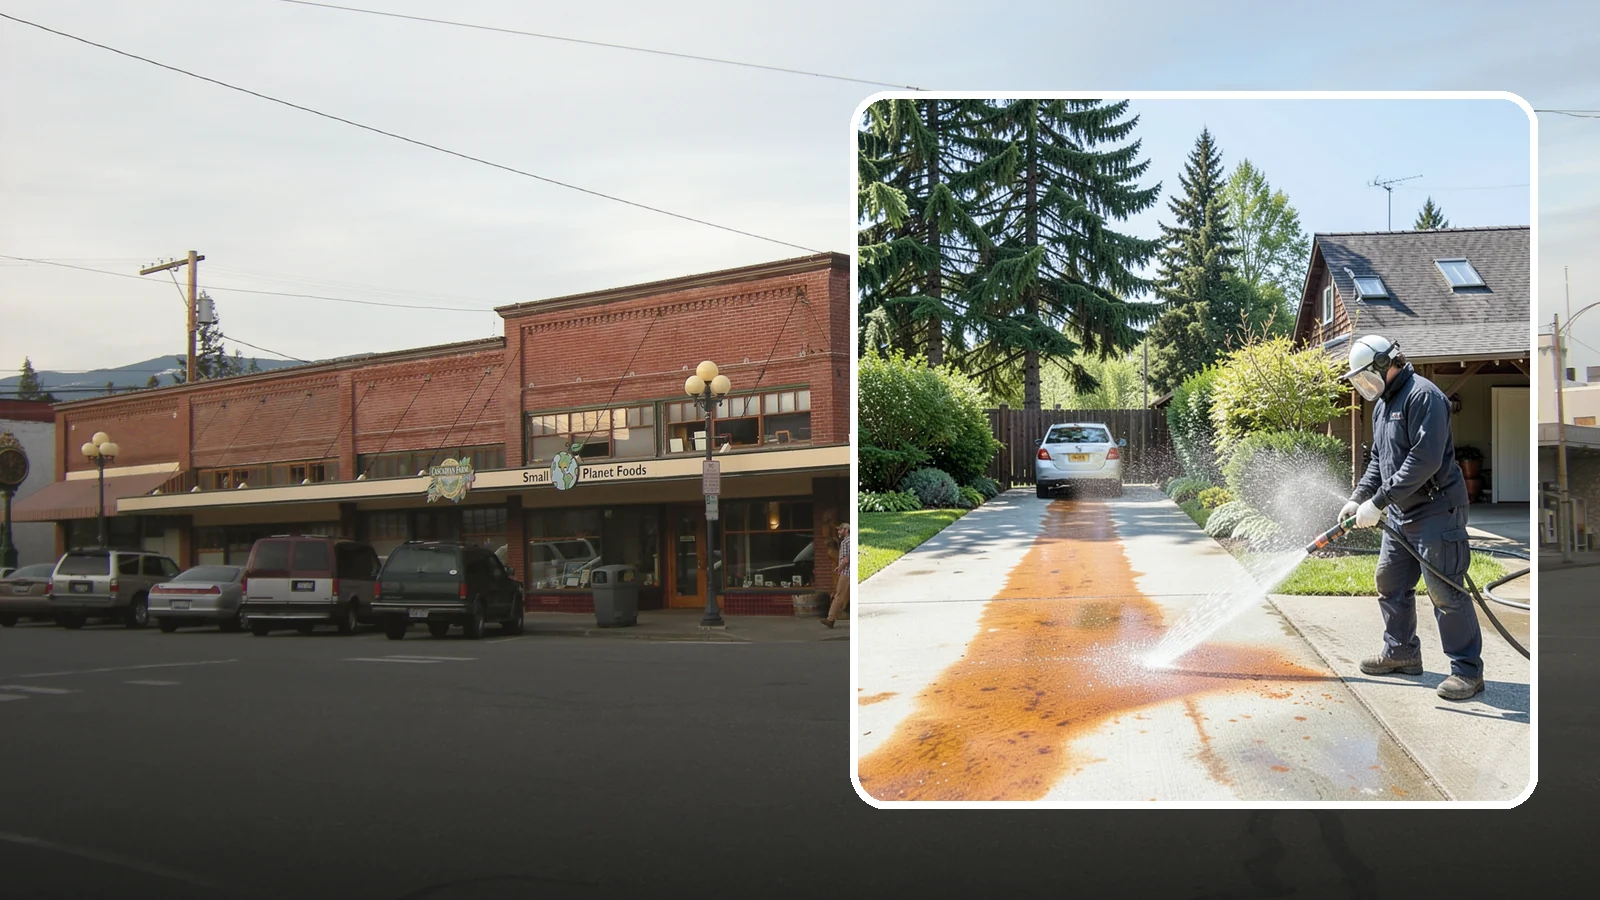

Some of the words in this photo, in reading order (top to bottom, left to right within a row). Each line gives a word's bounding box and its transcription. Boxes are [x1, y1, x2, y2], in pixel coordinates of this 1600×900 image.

[523, 471, 549, 483] Small
[583, 467, 614, 479] Planet
[617, 464, 647, 477] Foods
